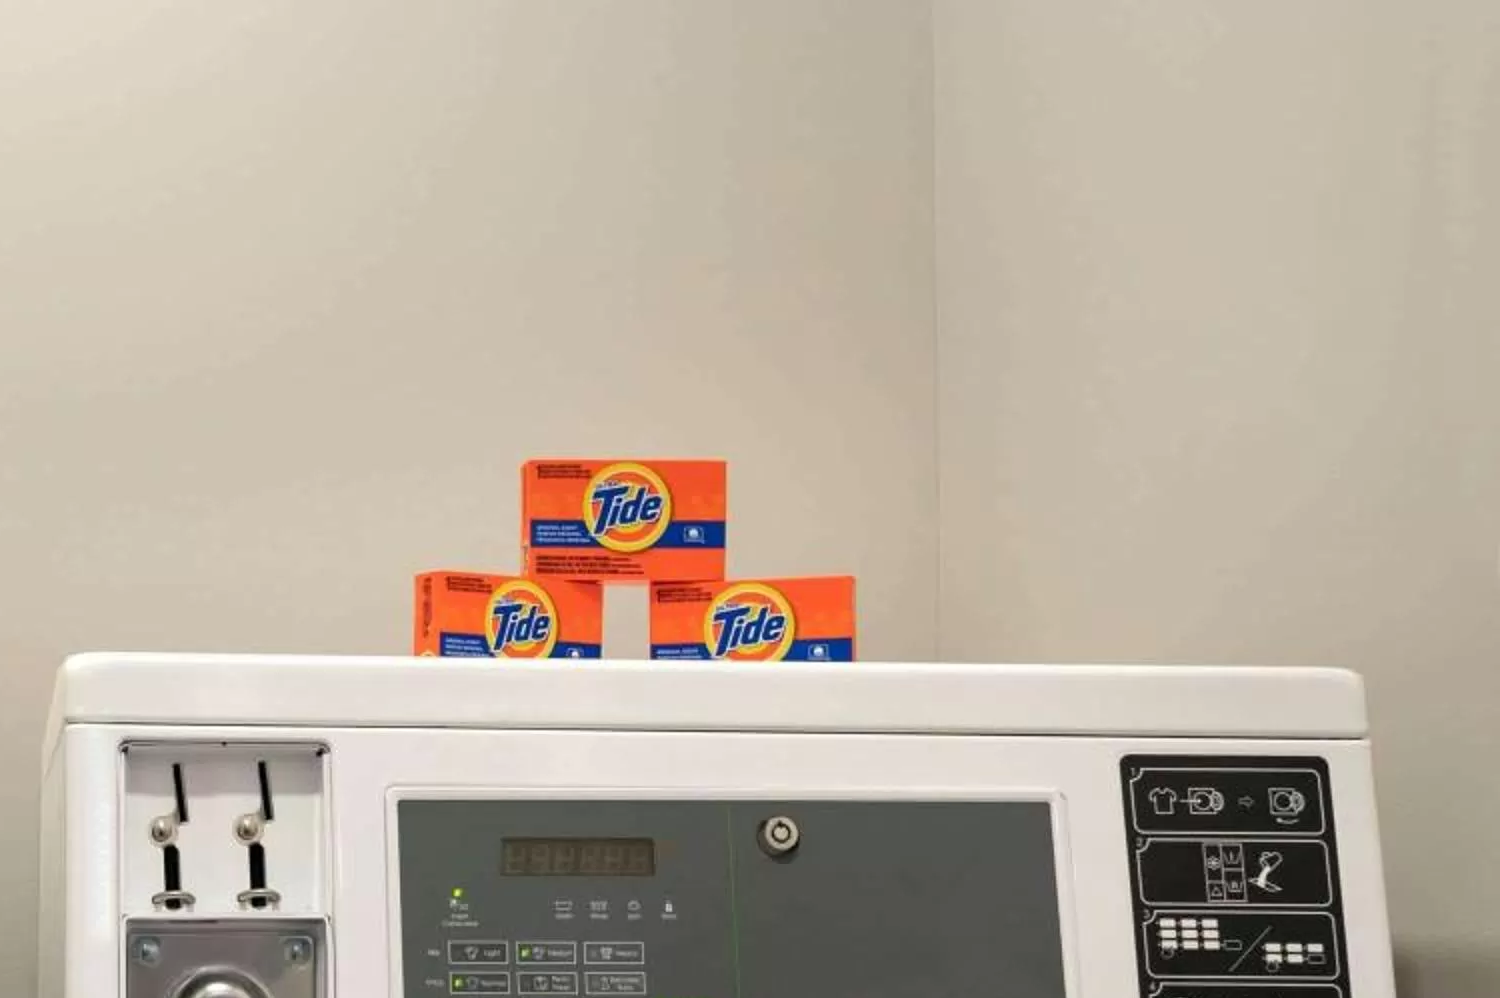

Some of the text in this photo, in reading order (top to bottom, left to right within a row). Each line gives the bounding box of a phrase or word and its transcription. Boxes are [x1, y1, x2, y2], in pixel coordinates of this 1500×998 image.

[592, 485, 664, 537] Tide
[493, 603, 550, 651] Tide
[713, 606, 786, 657] Tide
